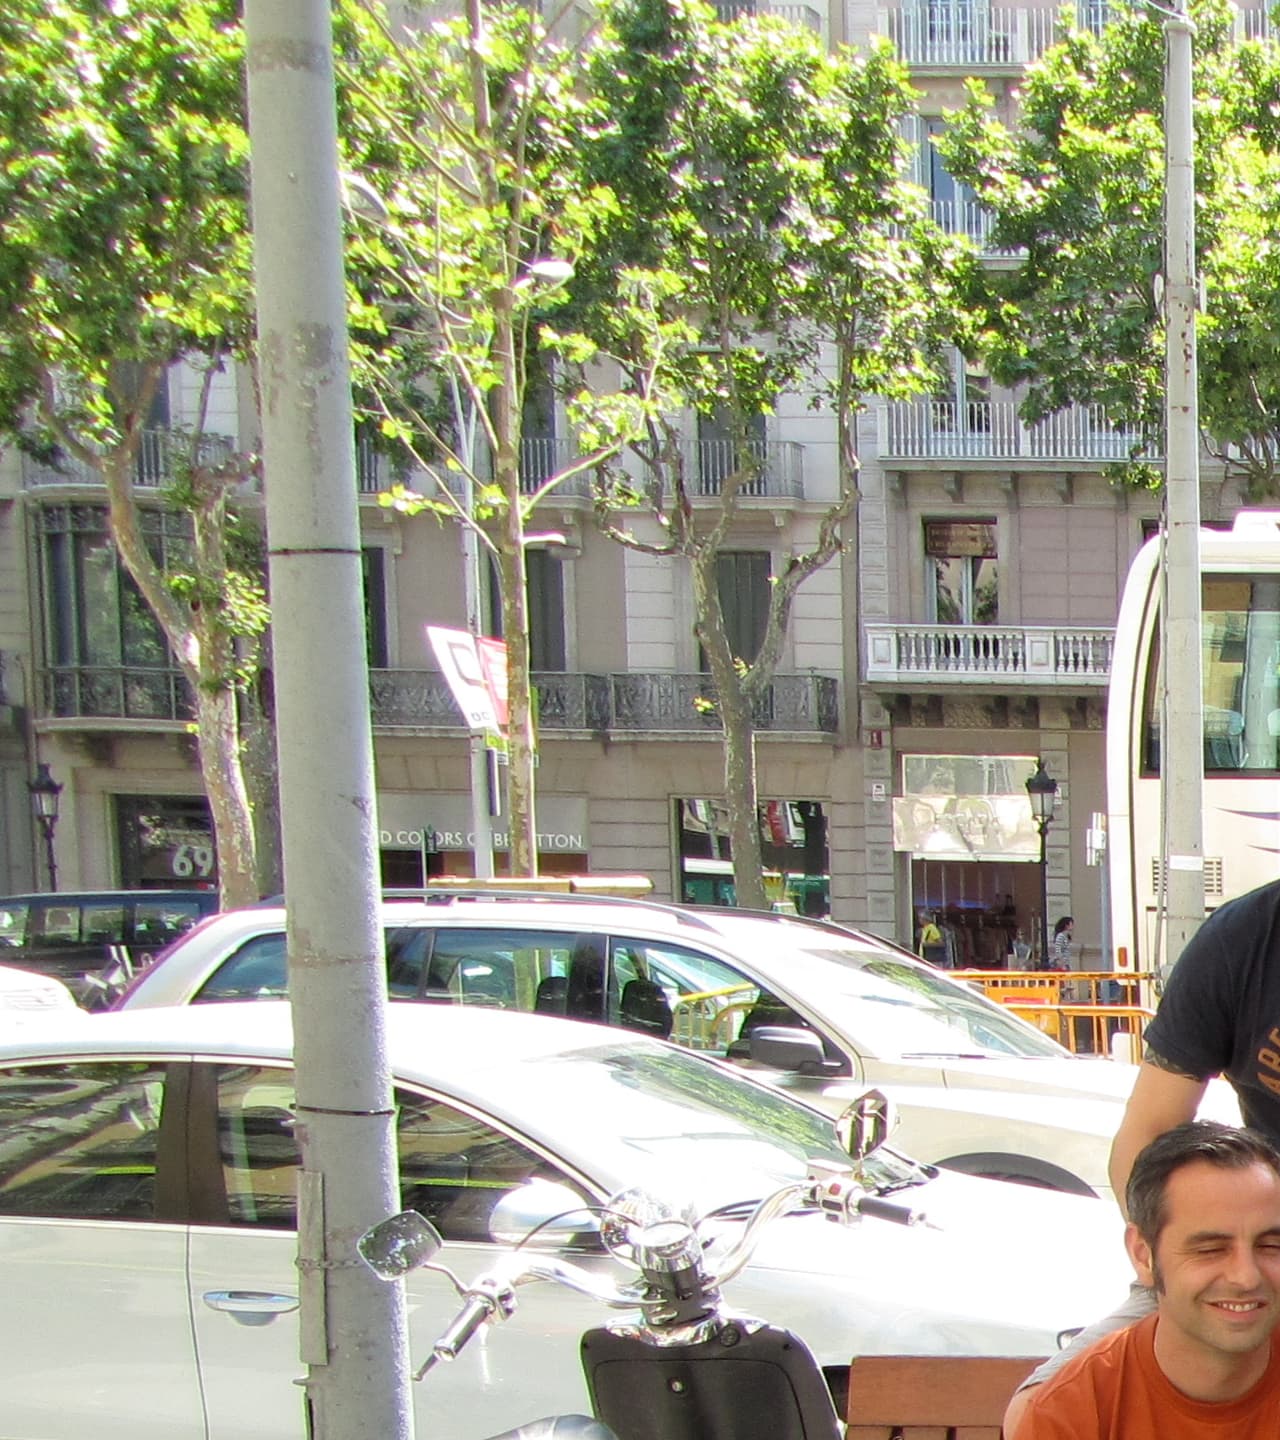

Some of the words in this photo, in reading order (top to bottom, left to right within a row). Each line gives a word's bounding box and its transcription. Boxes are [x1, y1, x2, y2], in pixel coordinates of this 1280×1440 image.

[397, 830, 462, 847] COORS
[495, 834, 582, 848] BETTON
[172, 844, 214, 877] 69
